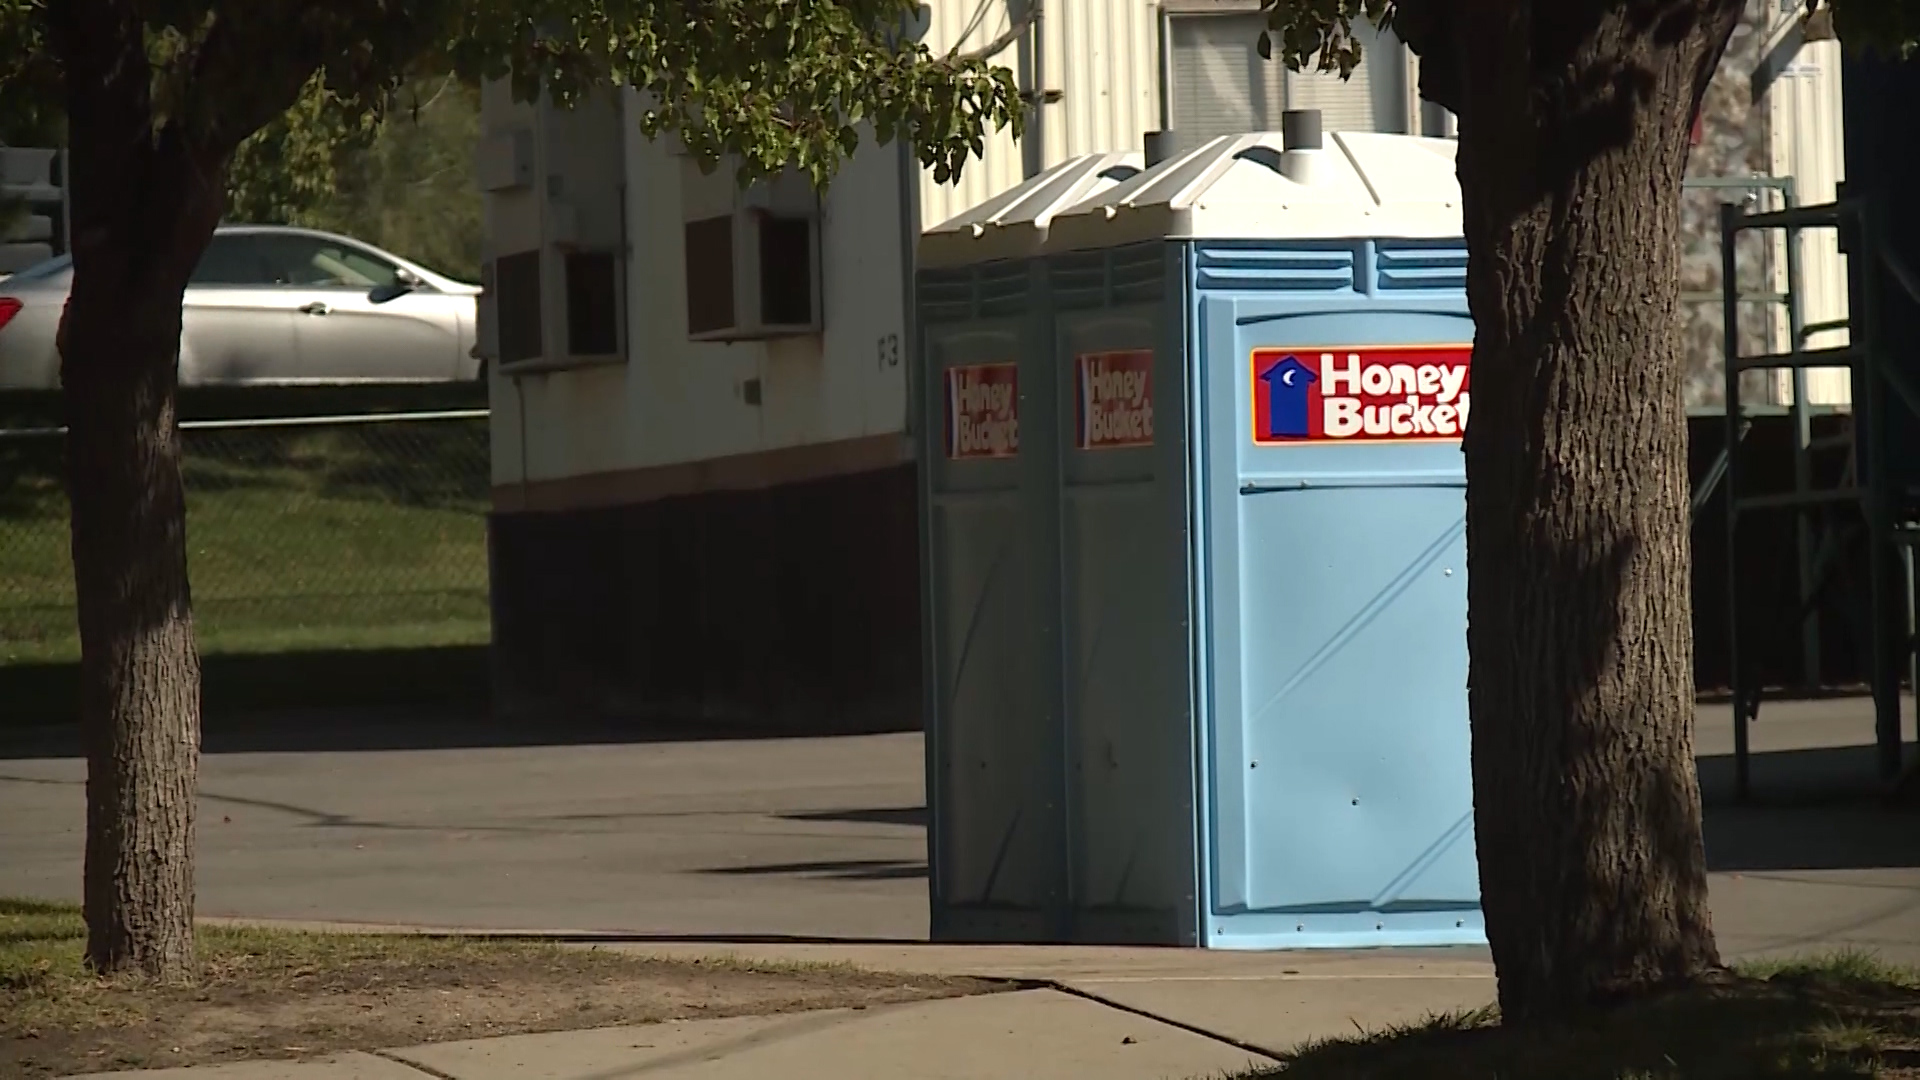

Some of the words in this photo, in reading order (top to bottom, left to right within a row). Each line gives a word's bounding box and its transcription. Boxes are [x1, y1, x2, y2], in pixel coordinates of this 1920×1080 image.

[958, 373, 1013, 420] Honey
[1090, 361, 1146, 407] Honey
[1320, 353, 1467, 403] Honey
[1090, 398, 1153, 442] Bucket
[1323, 392, 1470, 437] Bucket
